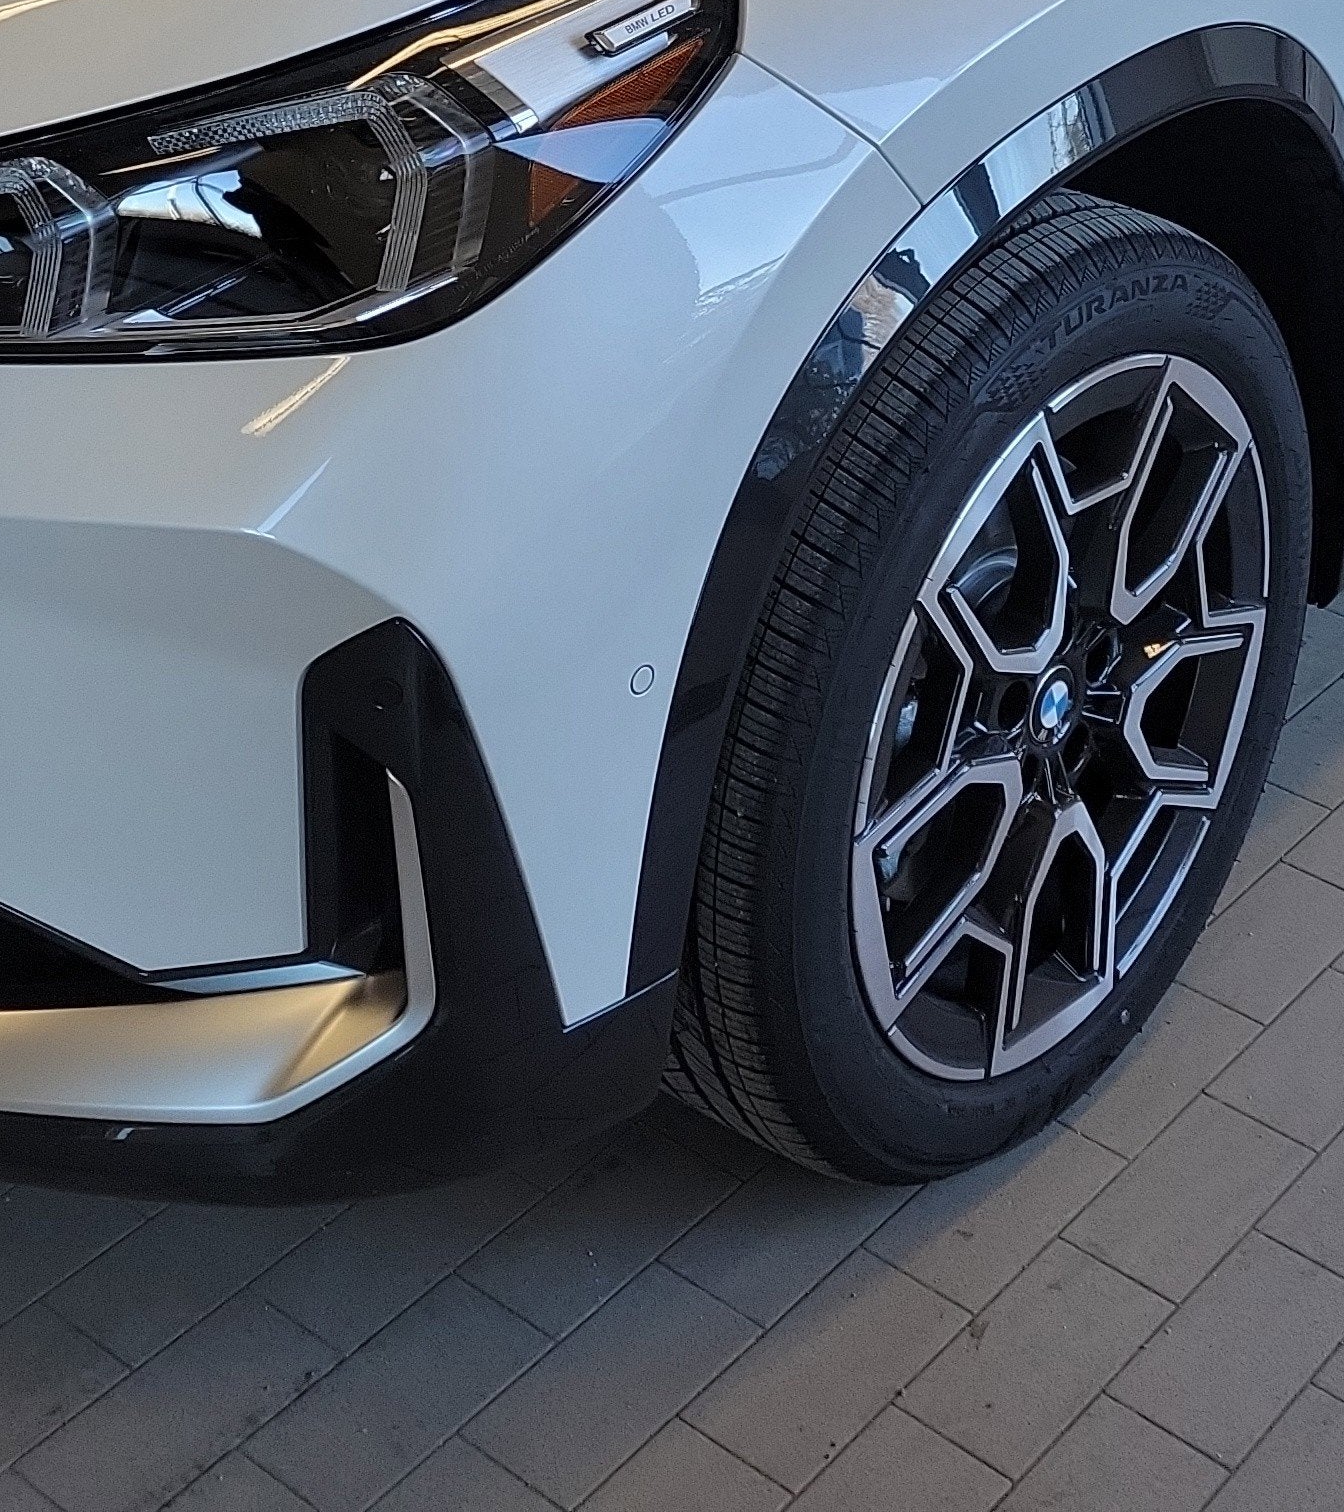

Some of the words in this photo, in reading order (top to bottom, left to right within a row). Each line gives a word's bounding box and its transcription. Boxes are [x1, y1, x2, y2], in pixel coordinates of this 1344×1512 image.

[625, 17, 649, 35] BMW
[650, 3, 676, 24] LED
[1040, 272, 1190, 352] TURANZA
